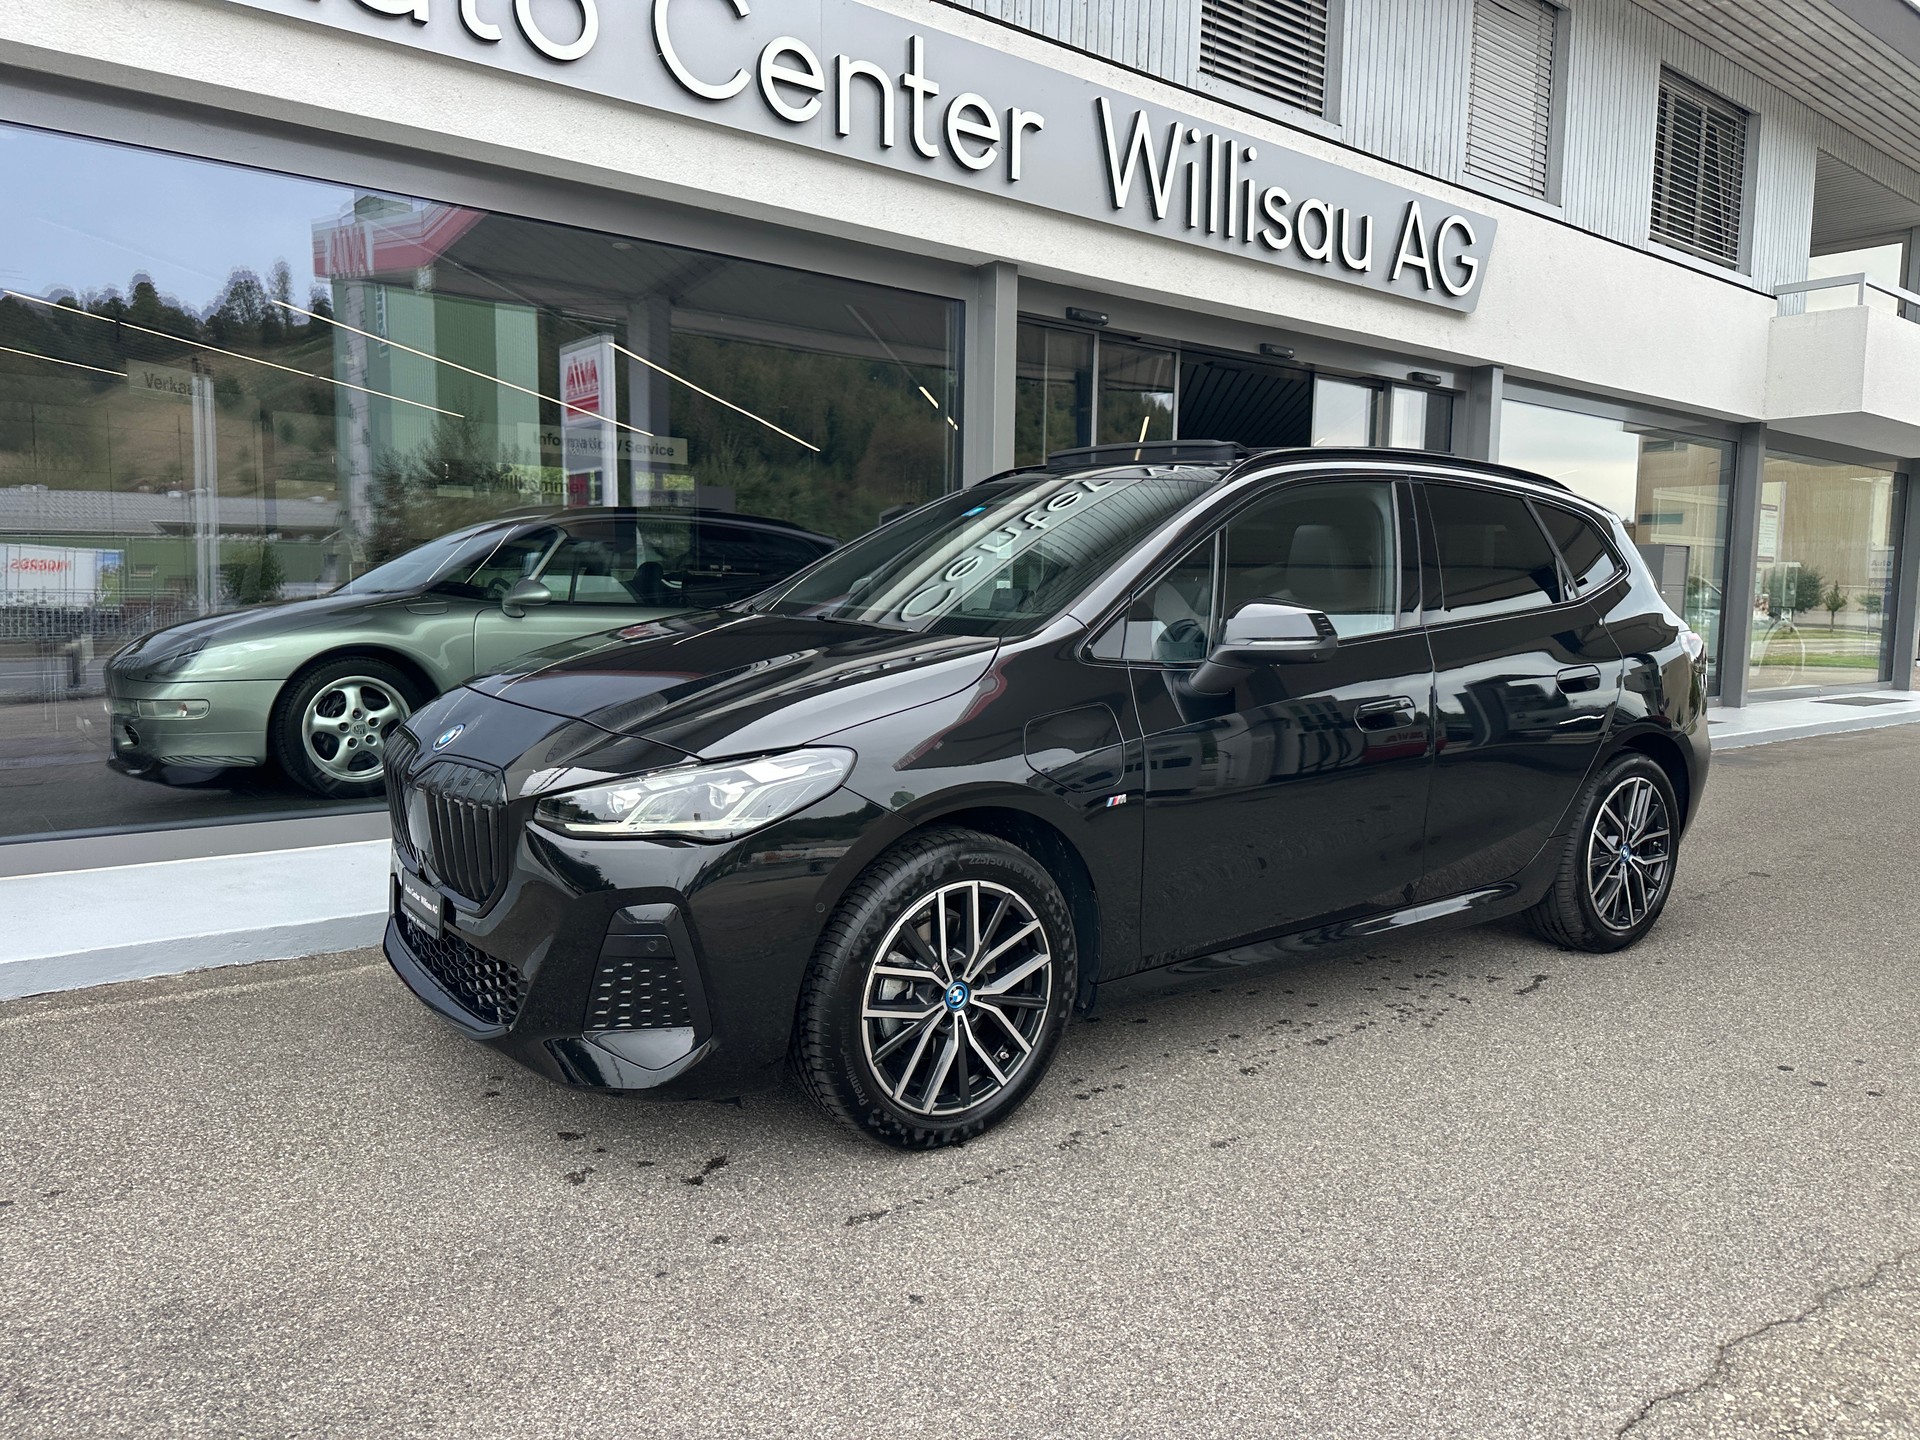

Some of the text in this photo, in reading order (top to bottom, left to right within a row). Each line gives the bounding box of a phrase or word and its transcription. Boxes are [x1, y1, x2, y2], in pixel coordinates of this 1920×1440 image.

[651, 0, 1480, 297] Center Willisau AG
[143, 371, 198, 395] Verkau
[625, 439, 675, 457] Service
[492, 471, 588, 495] illkommen
